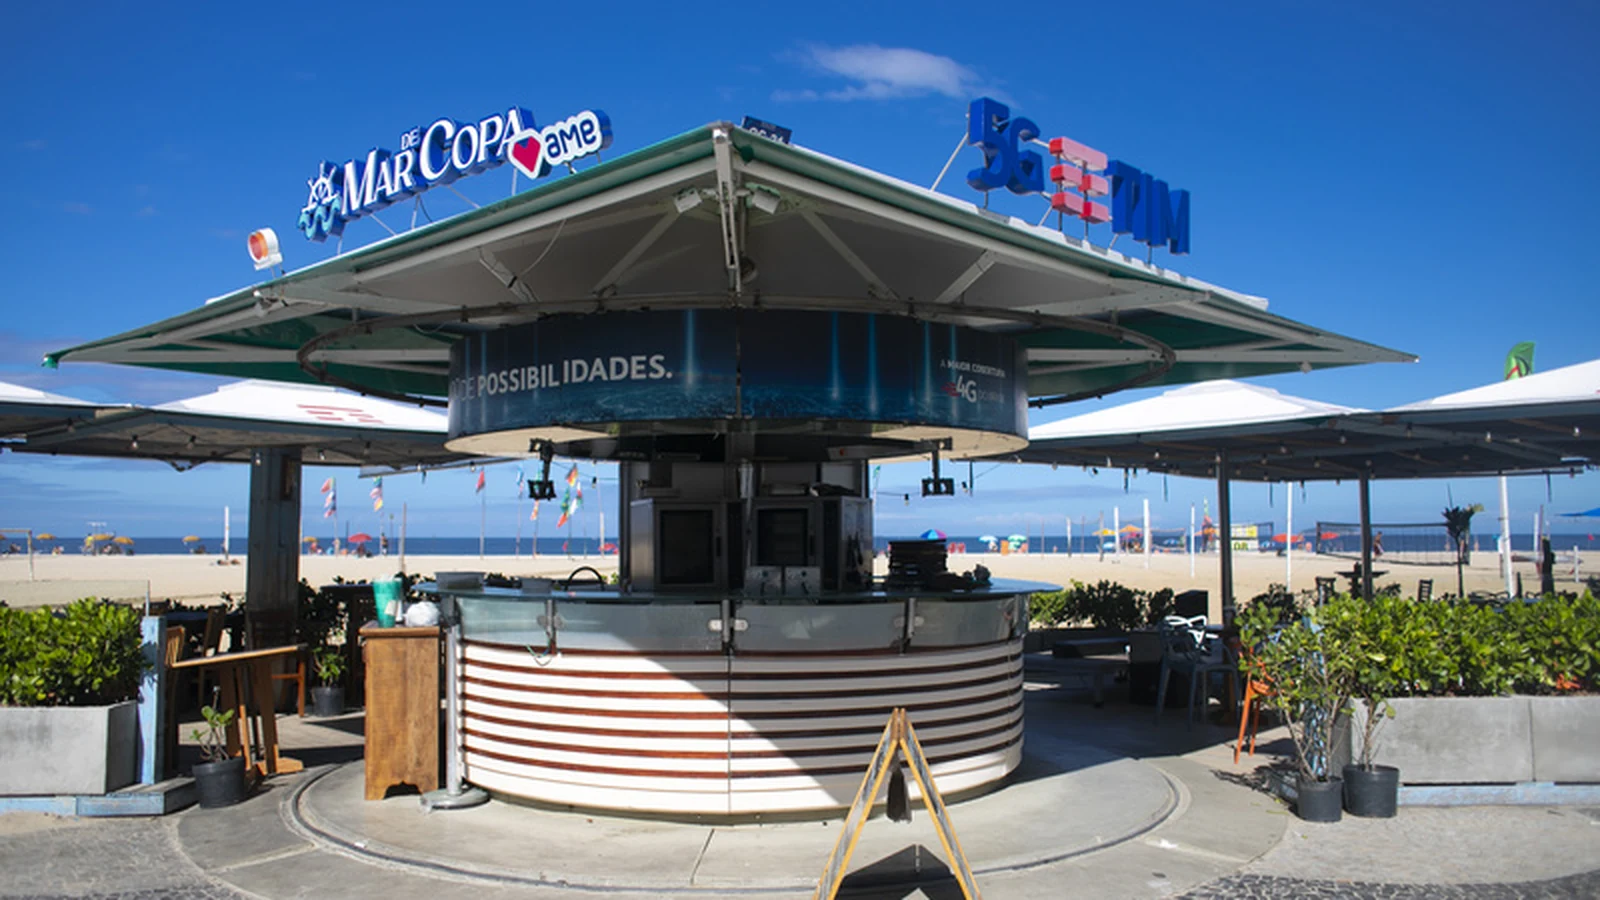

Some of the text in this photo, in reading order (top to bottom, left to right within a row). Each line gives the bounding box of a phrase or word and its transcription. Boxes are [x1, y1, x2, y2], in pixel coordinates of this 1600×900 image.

[418, 106, 524, 182] COPA
[967, 97, 1190, 255] 5G TIM
[957, 375, 977, 403] 4G
